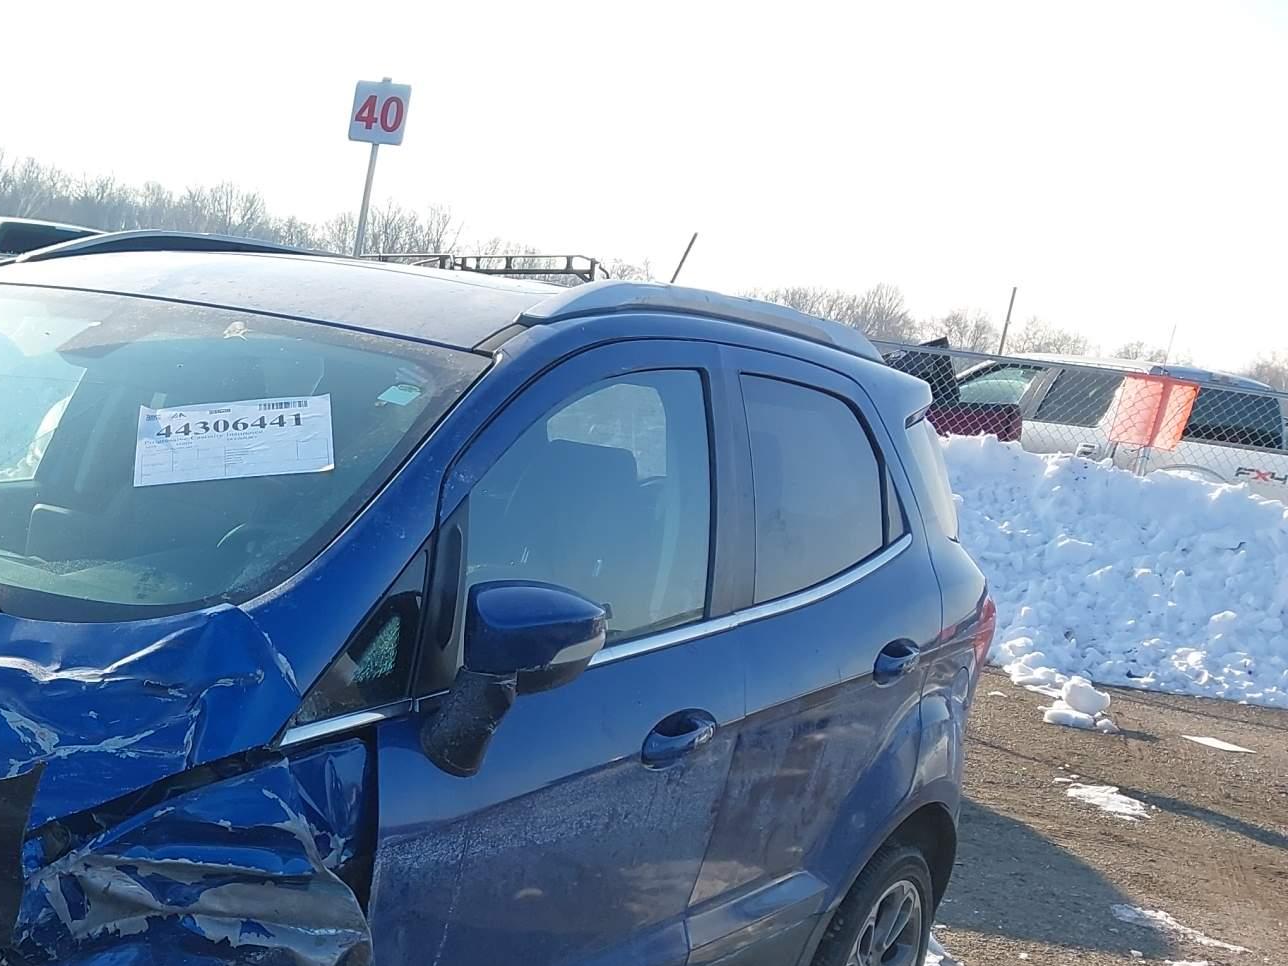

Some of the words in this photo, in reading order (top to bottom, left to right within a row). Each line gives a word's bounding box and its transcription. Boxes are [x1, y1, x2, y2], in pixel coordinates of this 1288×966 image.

[355, 95, 404, 133] 40
[156, 412, 303, 438] 44306441
[1235, 466, 1288, 485] FX4
